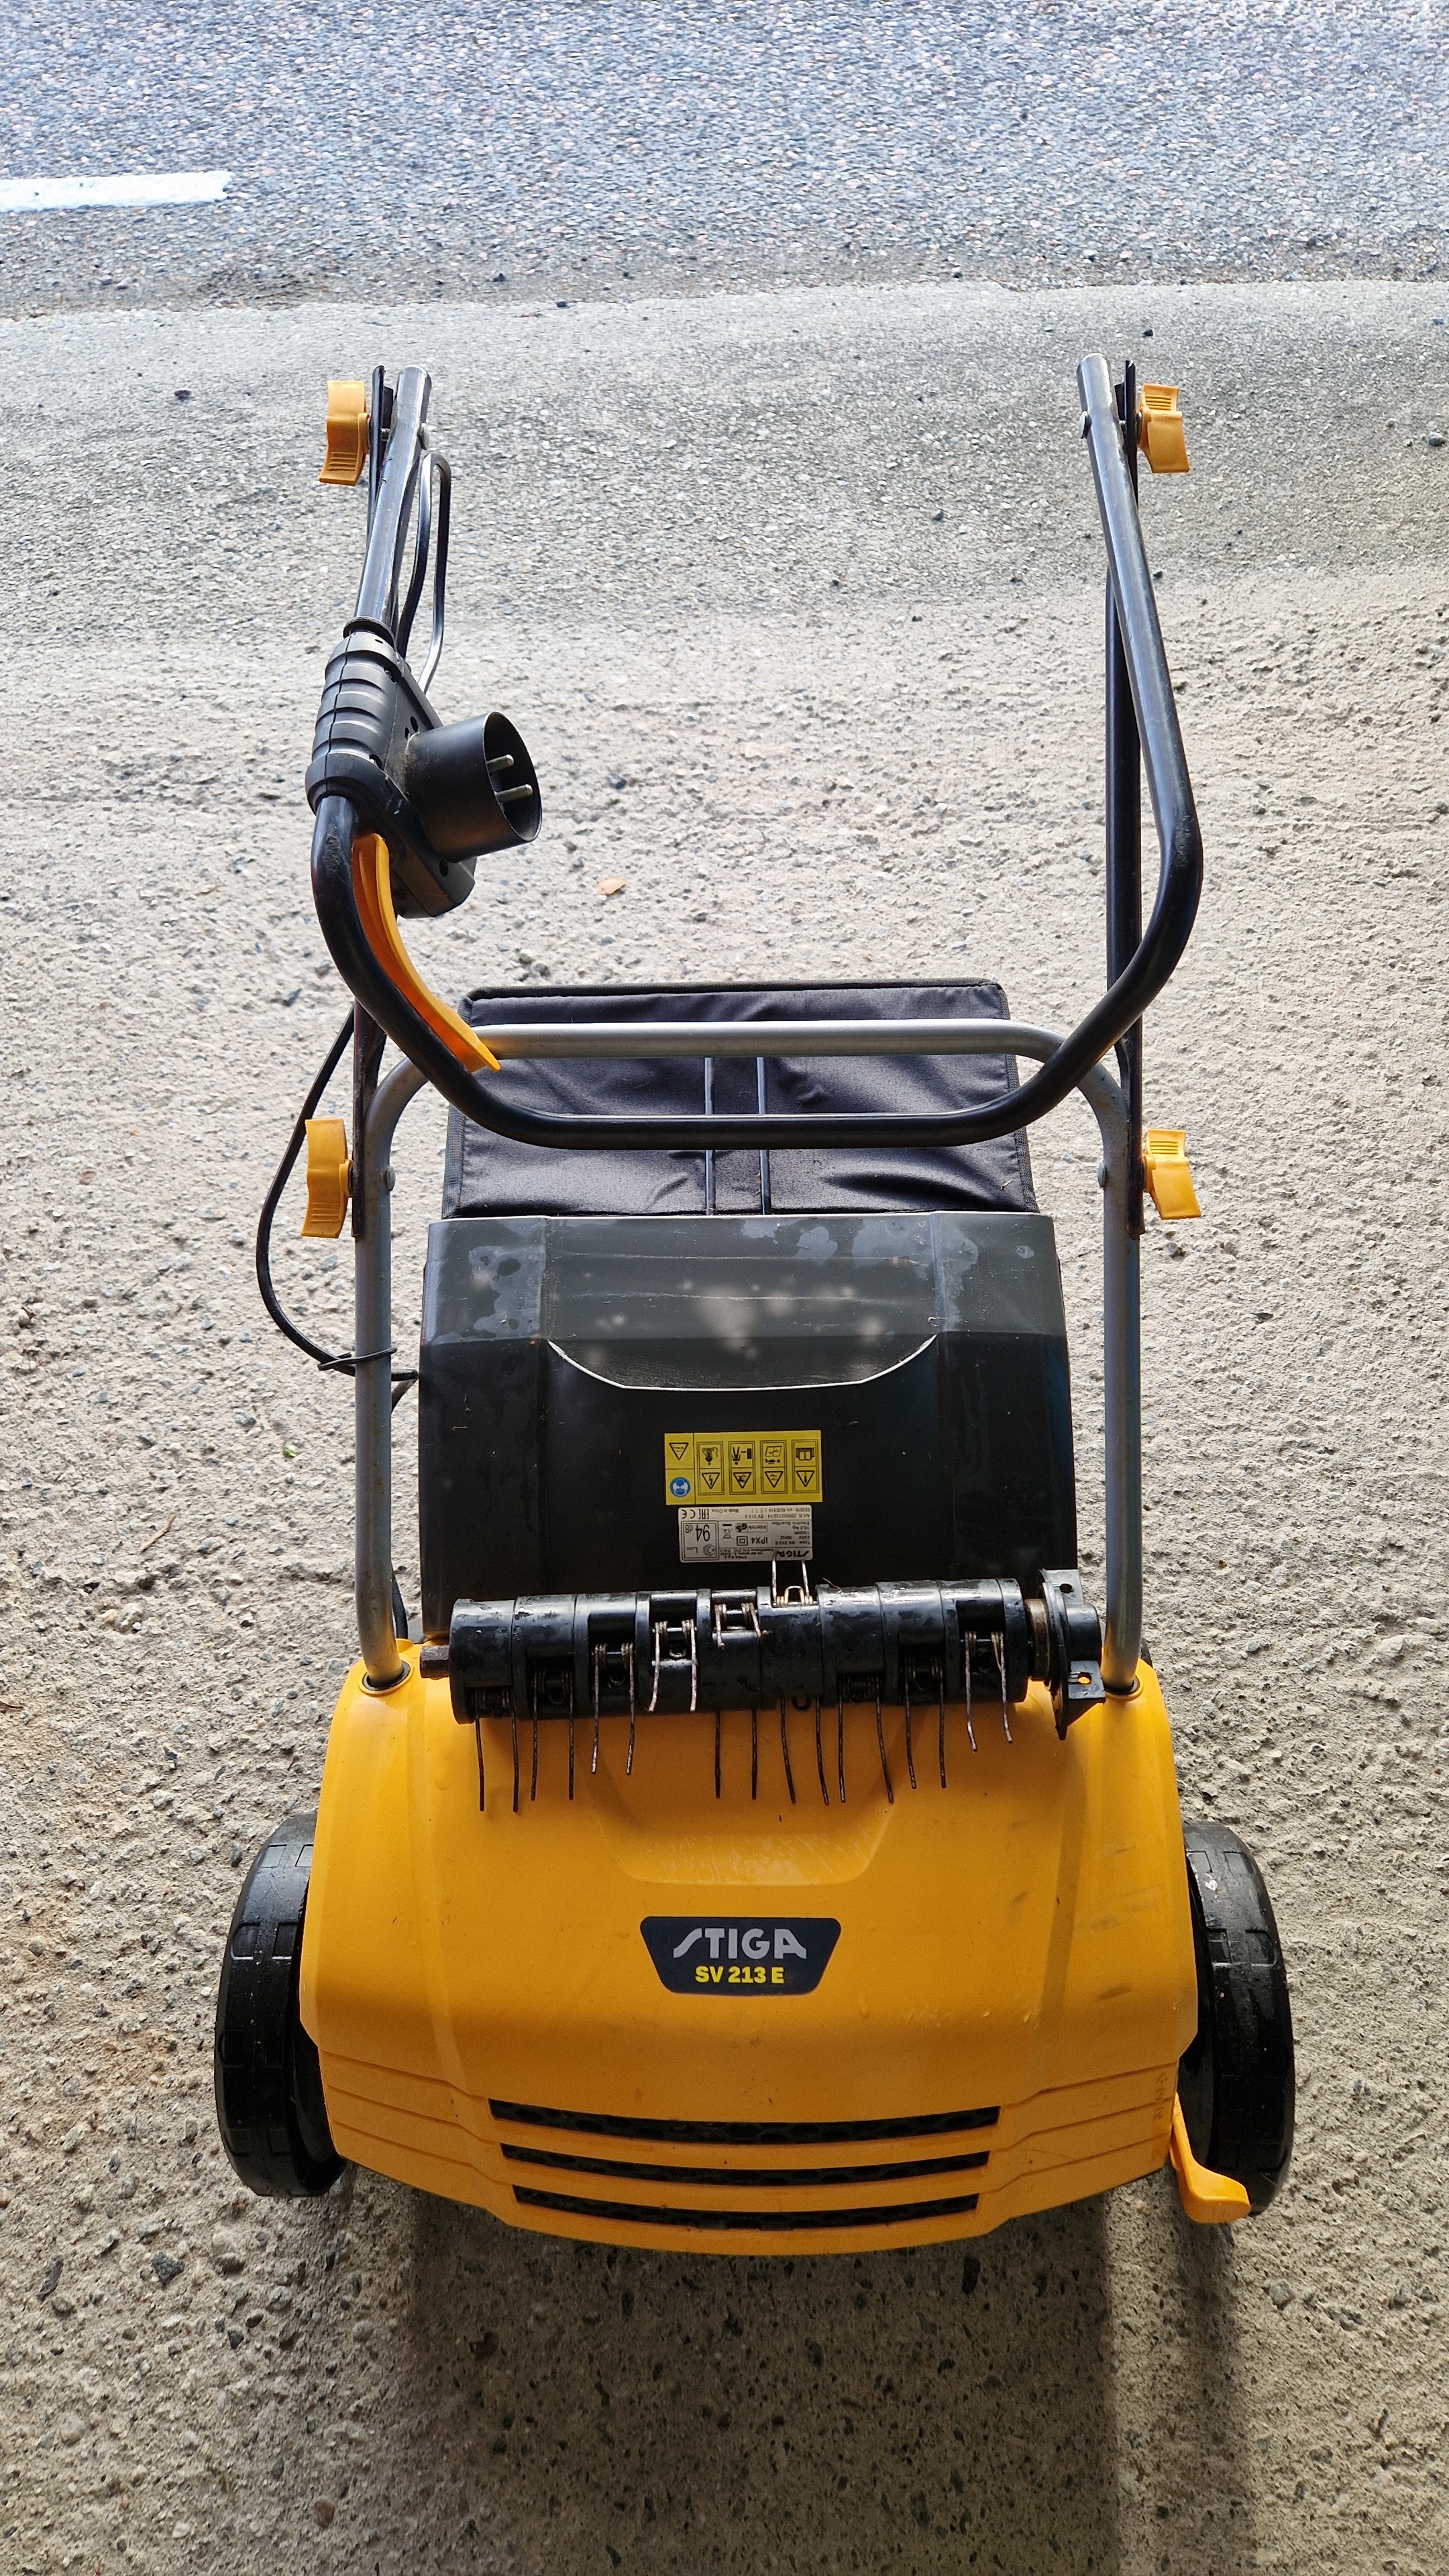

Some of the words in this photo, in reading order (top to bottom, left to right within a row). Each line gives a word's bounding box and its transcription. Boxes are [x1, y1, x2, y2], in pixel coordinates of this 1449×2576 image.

[685, 1525, 693, 1534] dB
[695, 1524, 710, 1542] 94
[736, 1523, 747, 1532] GS
[751, 1536, 768, 1544] IPX4
[673, 1928, 807, 1960] STIGA
[696, 1966, 724, 1984] SV
[727, 1966, 767, 1984] 213
[771, 1966, 785, 1984] E
